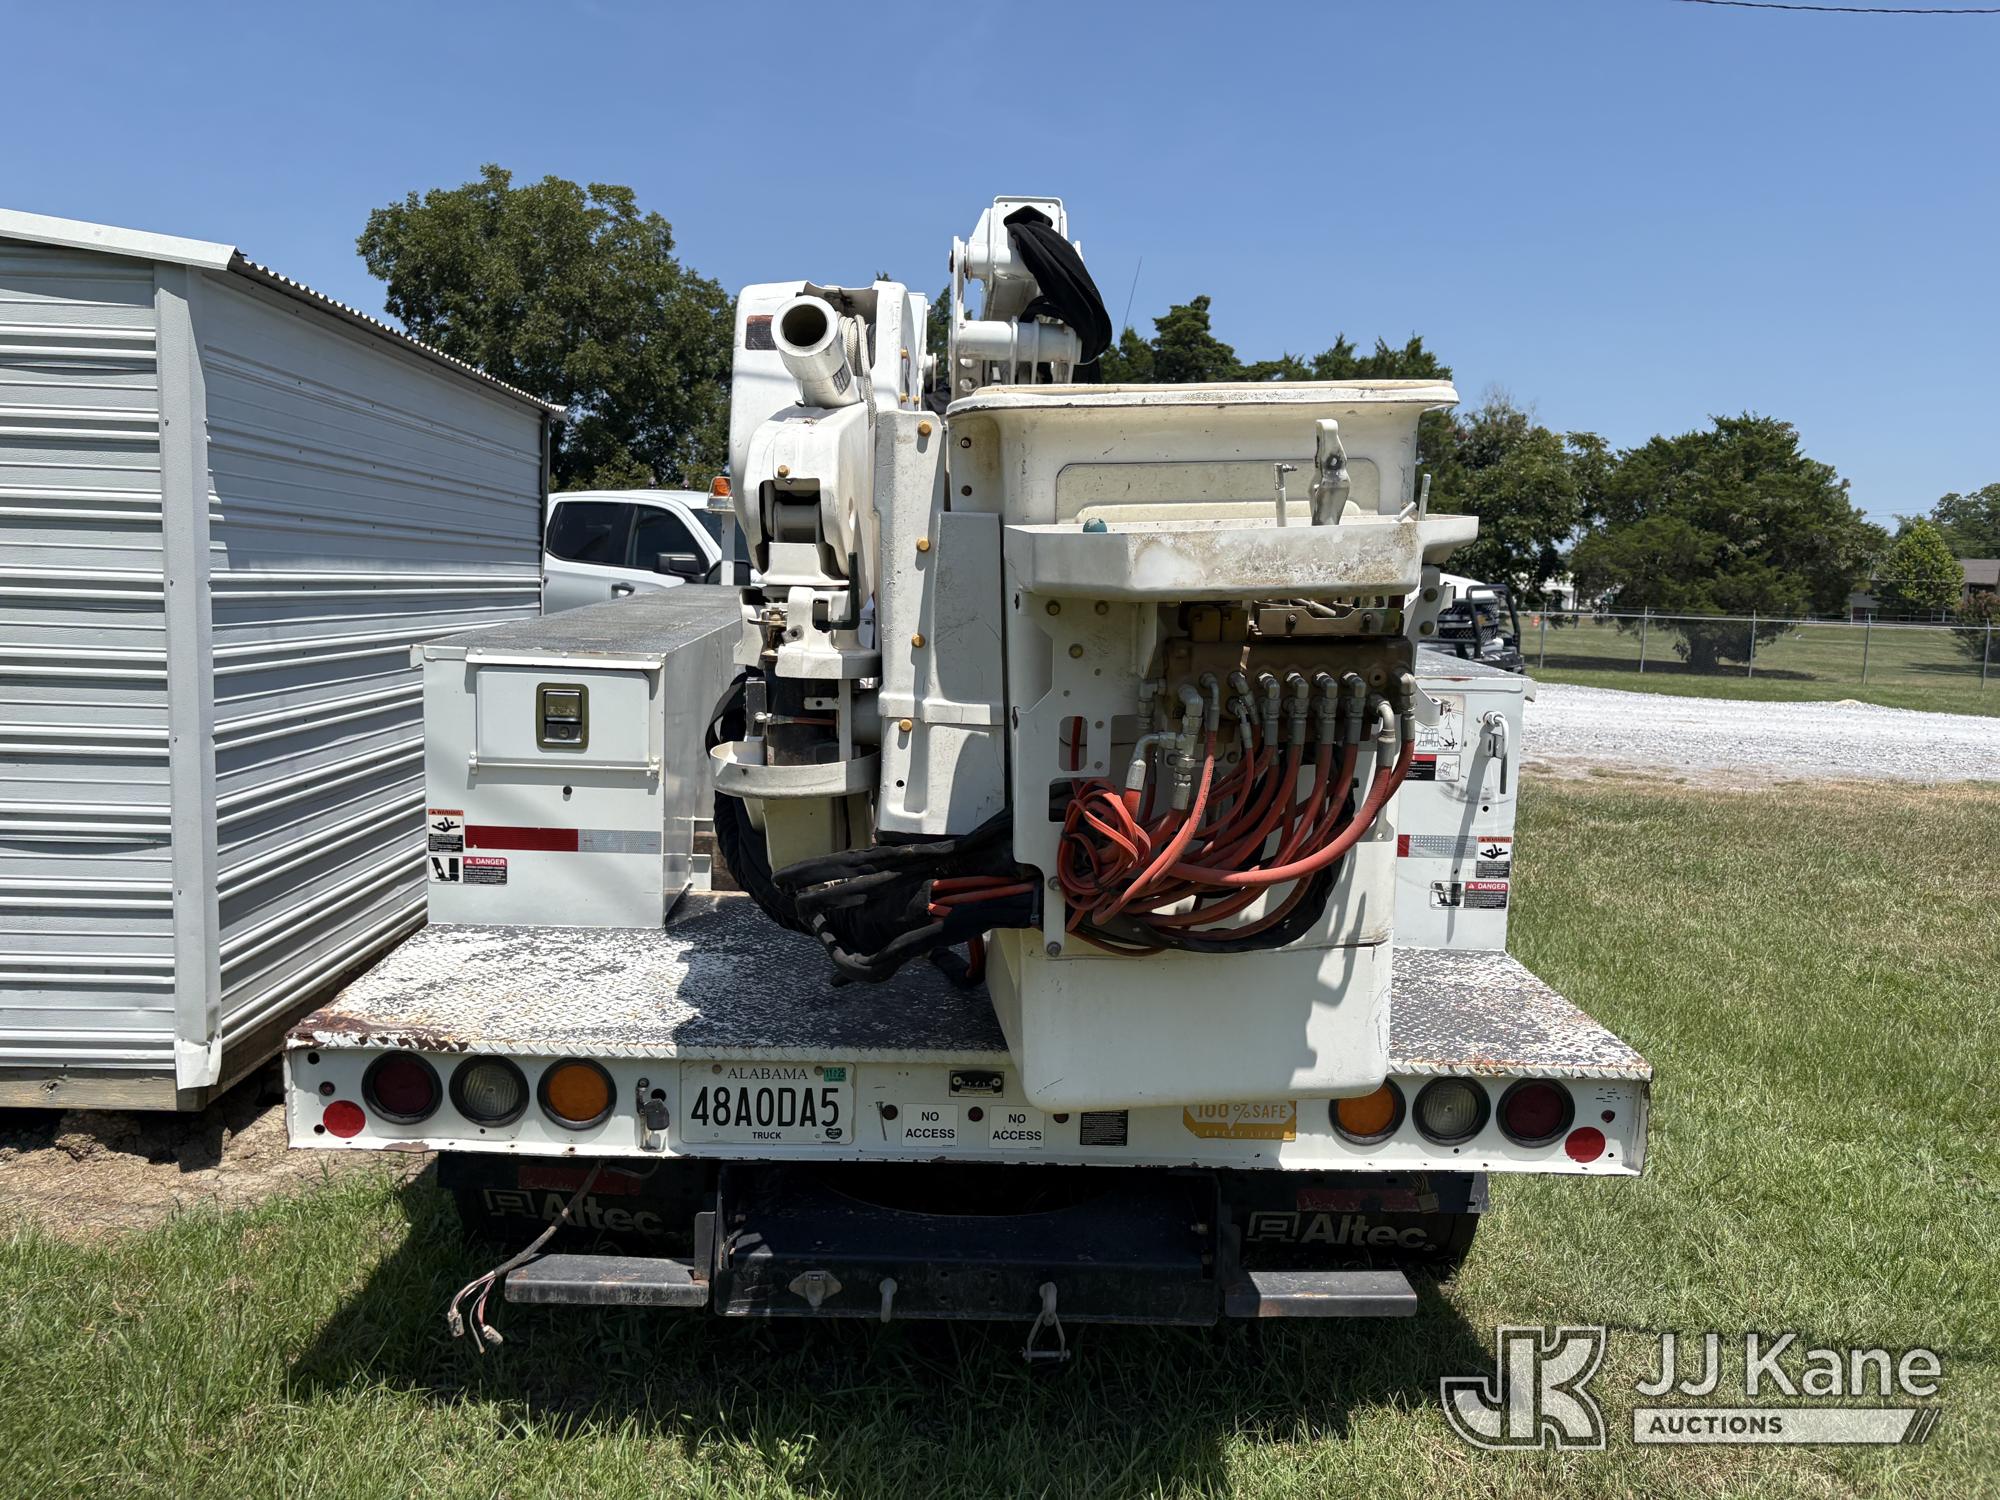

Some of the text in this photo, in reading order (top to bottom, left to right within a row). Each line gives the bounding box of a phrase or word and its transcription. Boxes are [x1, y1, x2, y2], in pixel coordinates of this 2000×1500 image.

[1477, 882, 1506, 890] DANGER
[727, 1067, 808, 1080] ALABAMA
[691, 1086, 840, 1127] 48A0DA5
[1253, 1104, 1287, 1119] SAFE
[921, 1111, 940, 1122] NO
[1008, 1113, 1026, 1124] NO
[752, 1131, 782, 1140] TRUCK
[905, 1128, 955, 1139] ACCESS
[992, 1129, 1042, 1141] ACCESS
[542, 1192, 664, 1235] Altec
[1299, 1213, 1428, 1249] Altec
